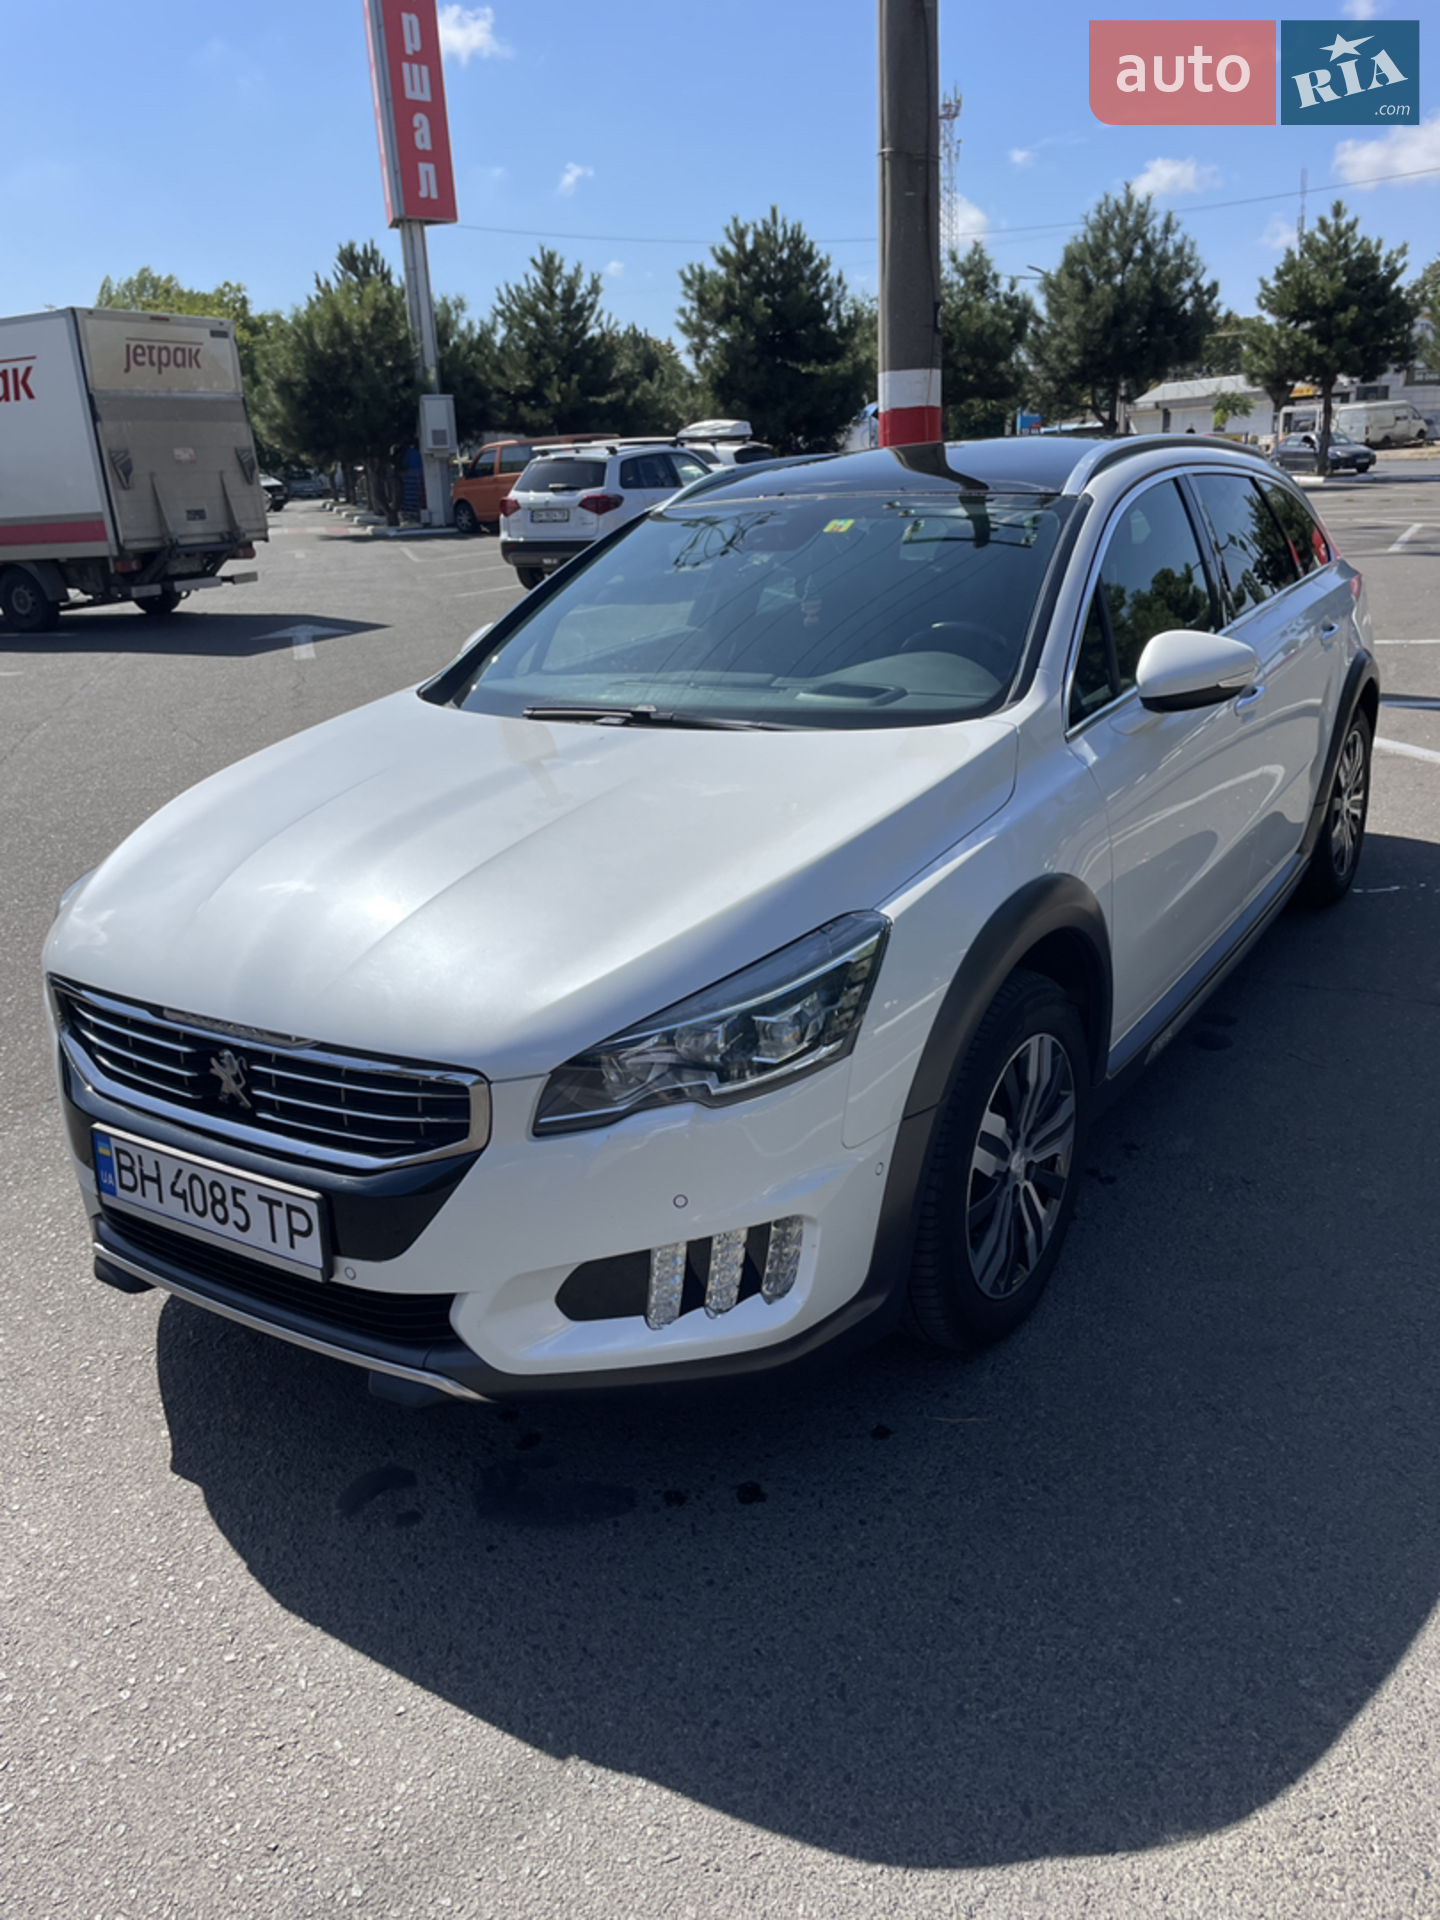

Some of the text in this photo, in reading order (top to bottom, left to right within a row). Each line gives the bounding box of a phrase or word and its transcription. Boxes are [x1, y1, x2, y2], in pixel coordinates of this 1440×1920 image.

[401, 0, 438, 200] ршал
[101, 1169, 116, 1187] UA
[114, 1146, 313, 1250] BH 4085 TP
